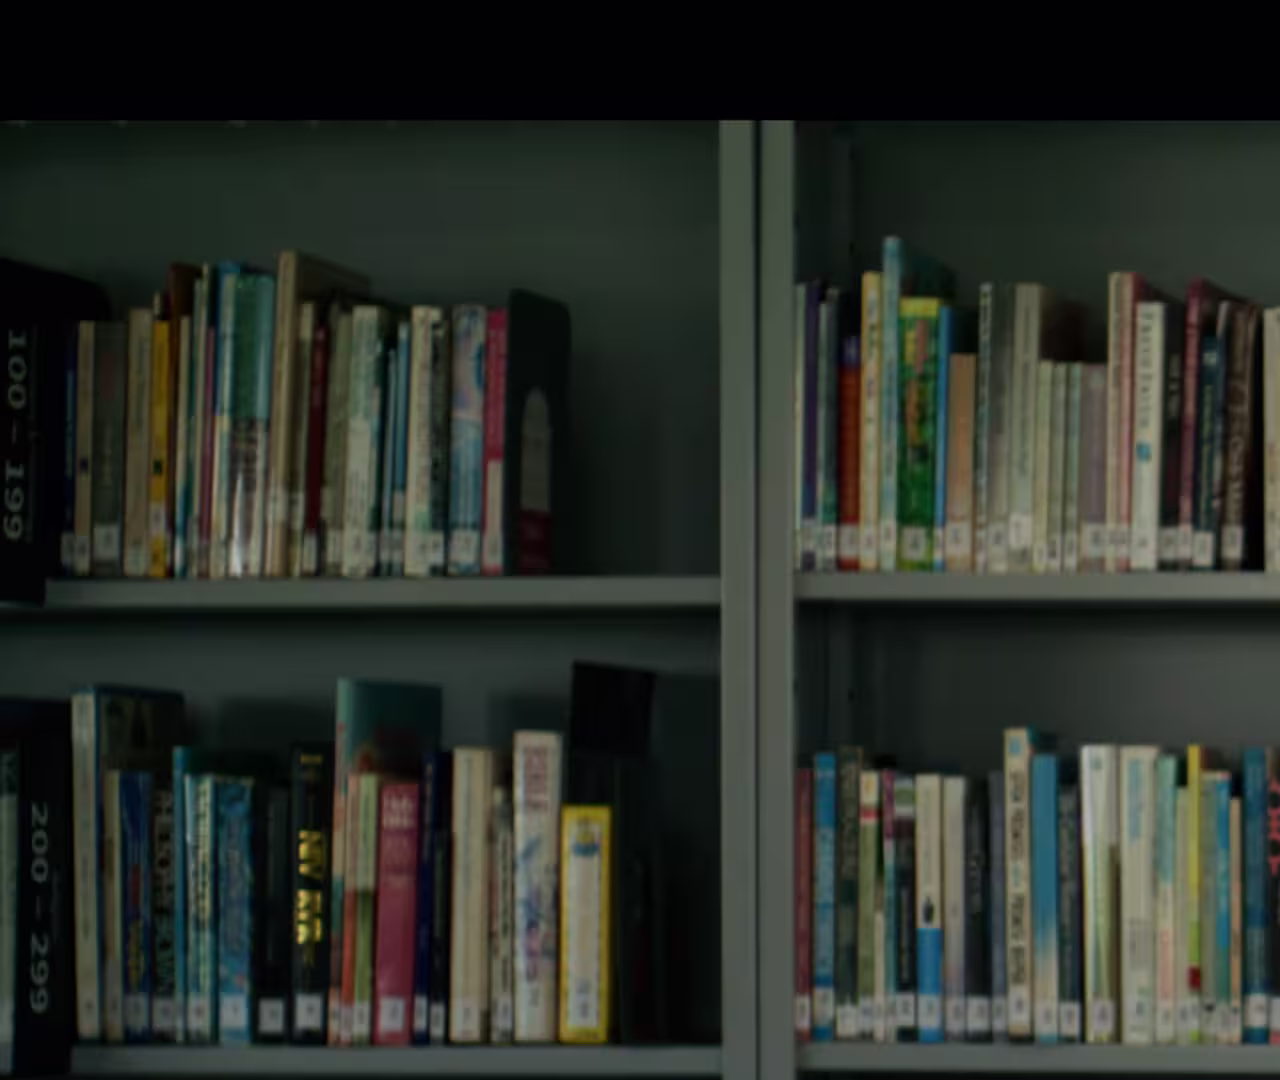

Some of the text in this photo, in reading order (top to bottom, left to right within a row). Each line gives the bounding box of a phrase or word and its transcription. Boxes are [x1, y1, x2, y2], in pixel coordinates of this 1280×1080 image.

[6, 328, 28, 411] 100
[3, 459, 26, 542] 199
[30, 800, 48, 884] 200
[29, 931, 49, 1014] 299
